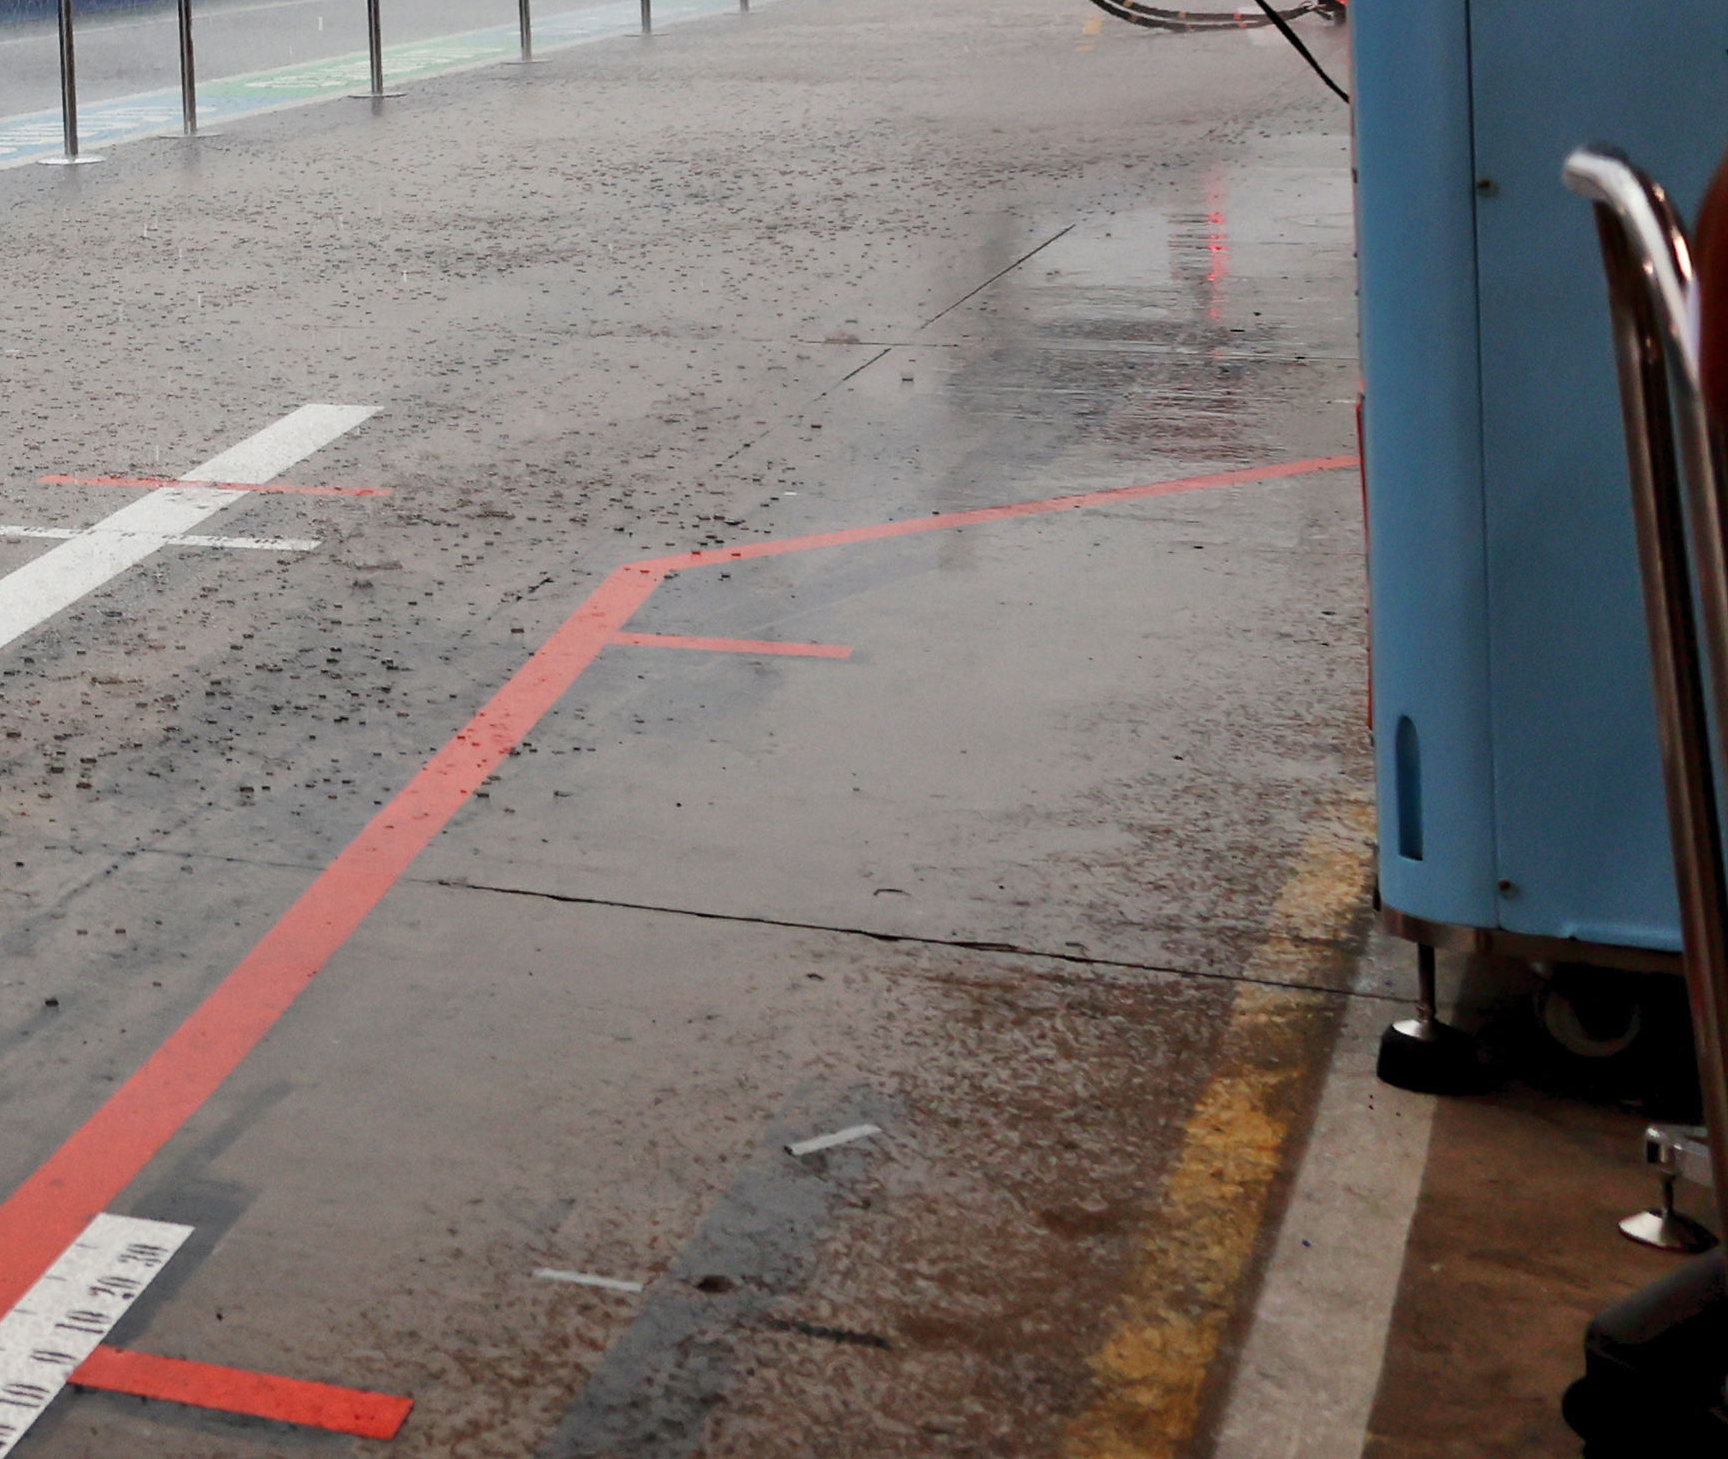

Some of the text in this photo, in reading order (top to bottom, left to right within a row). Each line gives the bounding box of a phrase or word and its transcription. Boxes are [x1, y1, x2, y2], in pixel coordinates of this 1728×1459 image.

[55, 1310, 112, 1335] 10
[88, 1275, 142, 1299] 20
[117, 1243, 169, 1268] 30
